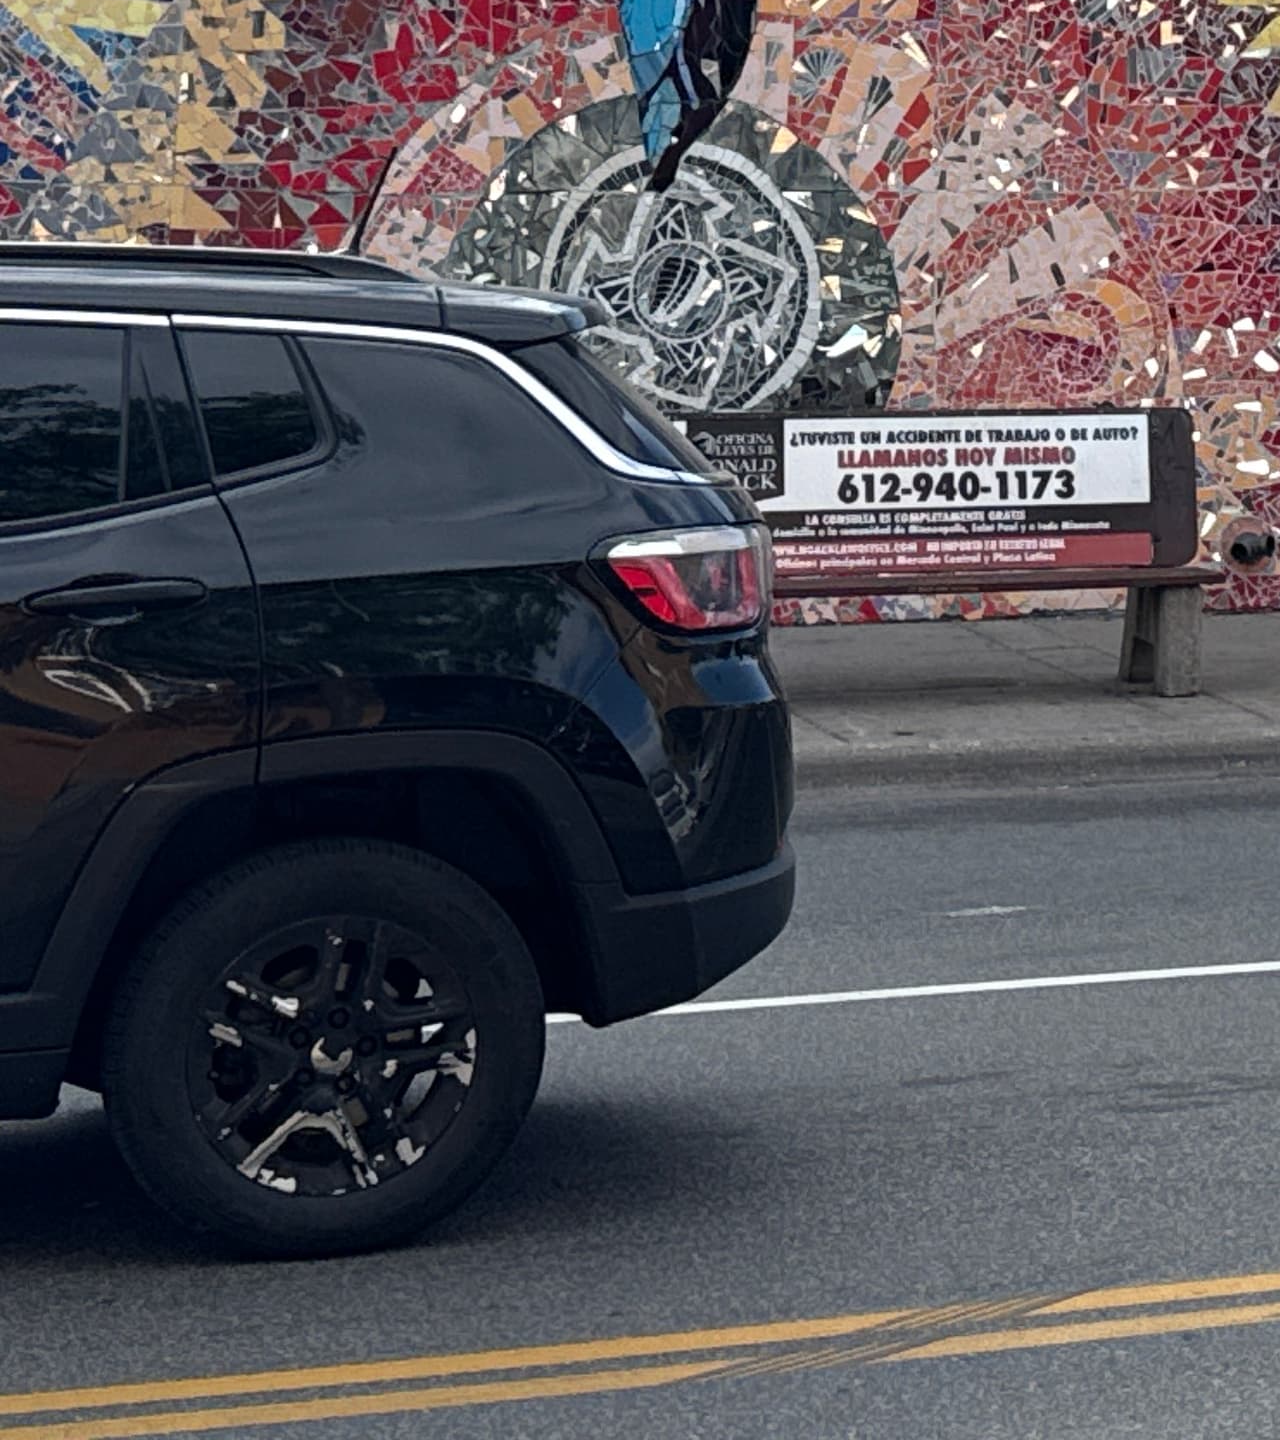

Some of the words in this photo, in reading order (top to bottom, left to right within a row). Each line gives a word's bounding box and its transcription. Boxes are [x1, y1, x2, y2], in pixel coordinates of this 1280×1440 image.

[790, 430, 856, 447] ¿TUVISTE
[860, 431, 881, 444] UN
[886, 429, 961, 444] ACCIDENTE
[965, 429, 982, 443] DE
[987, 428, 1051, 442] TRABAJO
[1055, 428, 1066, 441] O
[1070, 427, 1088, 441] DE
[1093, 426, 1139, 441] AUTO?
[838, 448, 948, 469] LLAMANOS
[955, 447, 997, 467] HOY
[1004, 445, 1076, 466] MISMO
[837, 469, 1076, 504] 612-940-1173
